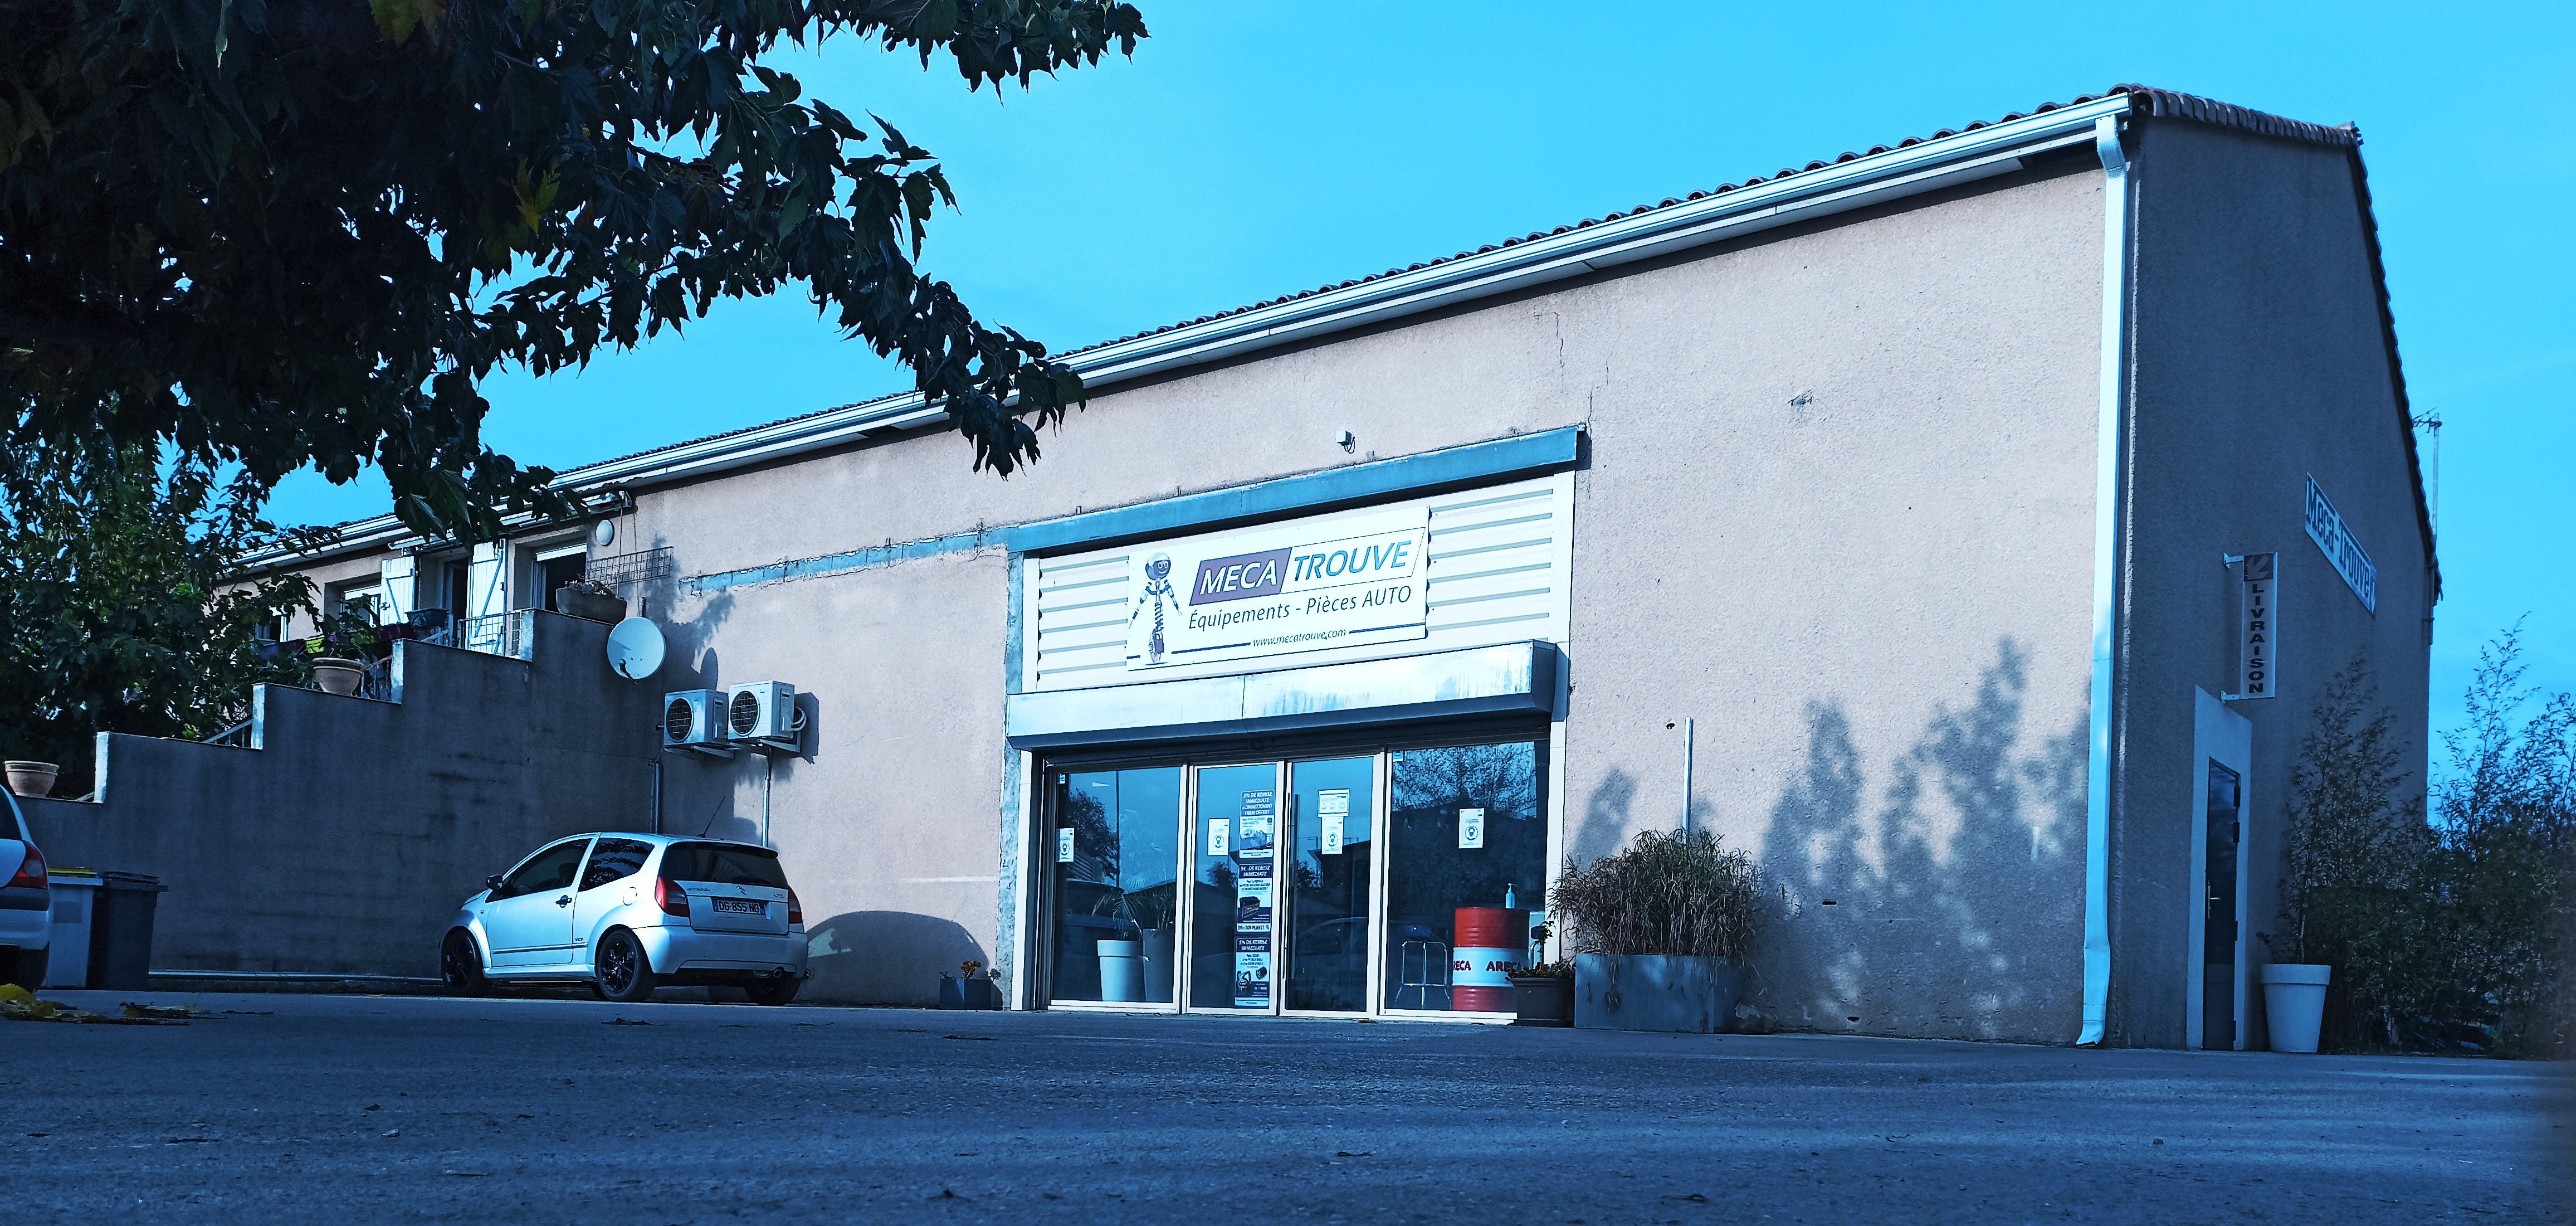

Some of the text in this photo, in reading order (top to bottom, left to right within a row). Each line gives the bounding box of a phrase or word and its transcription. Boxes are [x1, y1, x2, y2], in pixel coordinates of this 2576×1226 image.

[1199, 540, 1412, 595] MECA TROUVE
[1189, 604, 1290, 632] Équipements
[1306, 593, 1357, 615] Pièces
[1362, 585, 1411, 608] AUTO
[1253, 629, 1346, 647] www.mecatrouve.com
[2248, 583, 2265, 694] LIVRAISON
[1453, 960, 1523, 972] RECA ARECA
